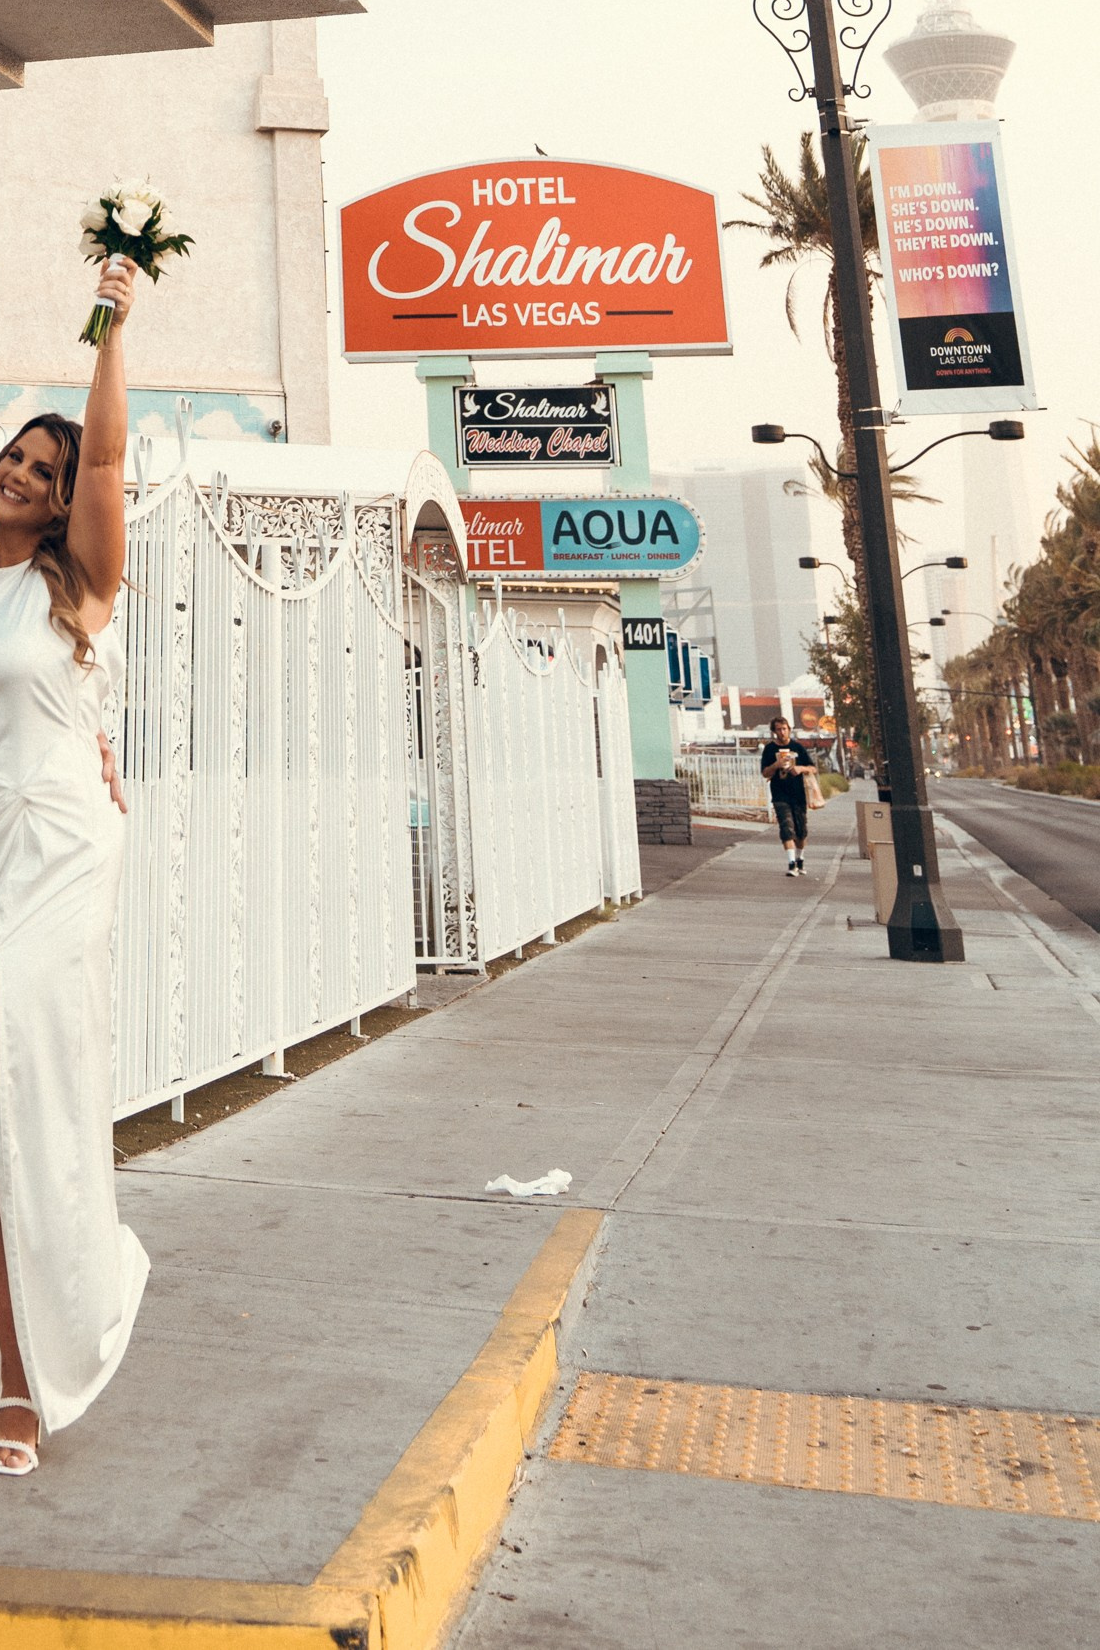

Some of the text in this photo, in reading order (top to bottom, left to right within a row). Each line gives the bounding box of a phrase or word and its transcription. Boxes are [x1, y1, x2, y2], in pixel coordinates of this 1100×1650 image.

[472, 177, 576, 206] HOTEL
[889, 182, 962, 199] I'M DOWN.
[891, 198, 980, 217] SHE'S DOWN.
[893, 216, 974, 235] HE'S DOWN.
[367, 200, 693, 300] Shalimar
[895, 232, 999, 252] THEY'RE DOWN.
[899, 262, 999, 283] WHO'S DOWN?
[462, 302, 600, 327] LAS VEGAS
[930, 344, 992, 357] DOWNTOWN
[940, 355, 984, 365] LAS VEGAS
[483, 392, 588, 420] Shalimar
[466, 427, 609, 460] Wedding Chapel
[465, 511, 525, 536] alimar
[552, 509, 680, 549] AQUA
[467, 539, 526, 565] TEL
[553, 553, 605, 561] BREAKFAST
[624, 622, 663, 646] 1401
